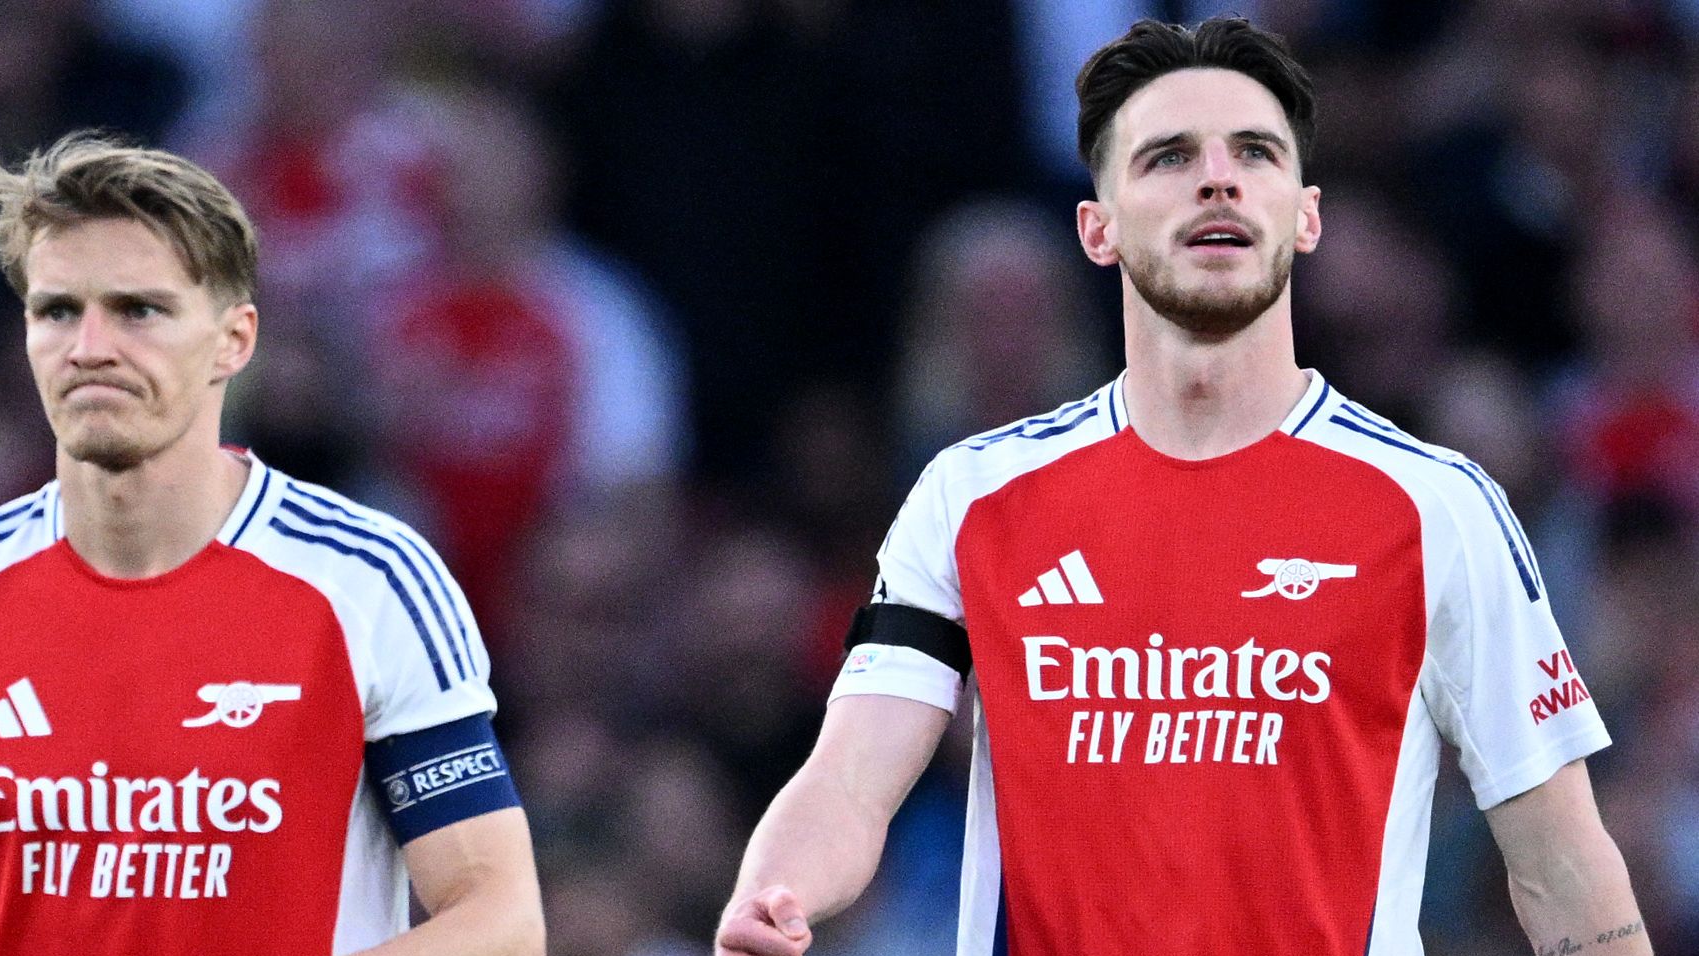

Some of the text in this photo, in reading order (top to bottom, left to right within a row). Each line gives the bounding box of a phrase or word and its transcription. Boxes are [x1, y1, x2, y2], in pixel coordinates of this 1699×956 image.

[1021, 633, 1332, 704] Emirates
[1067, 710, 1284, 765] FLY BETTER
[412, 750, 501, 793] RESPECT
[22, 841, 232, 899] FLY BETTER
